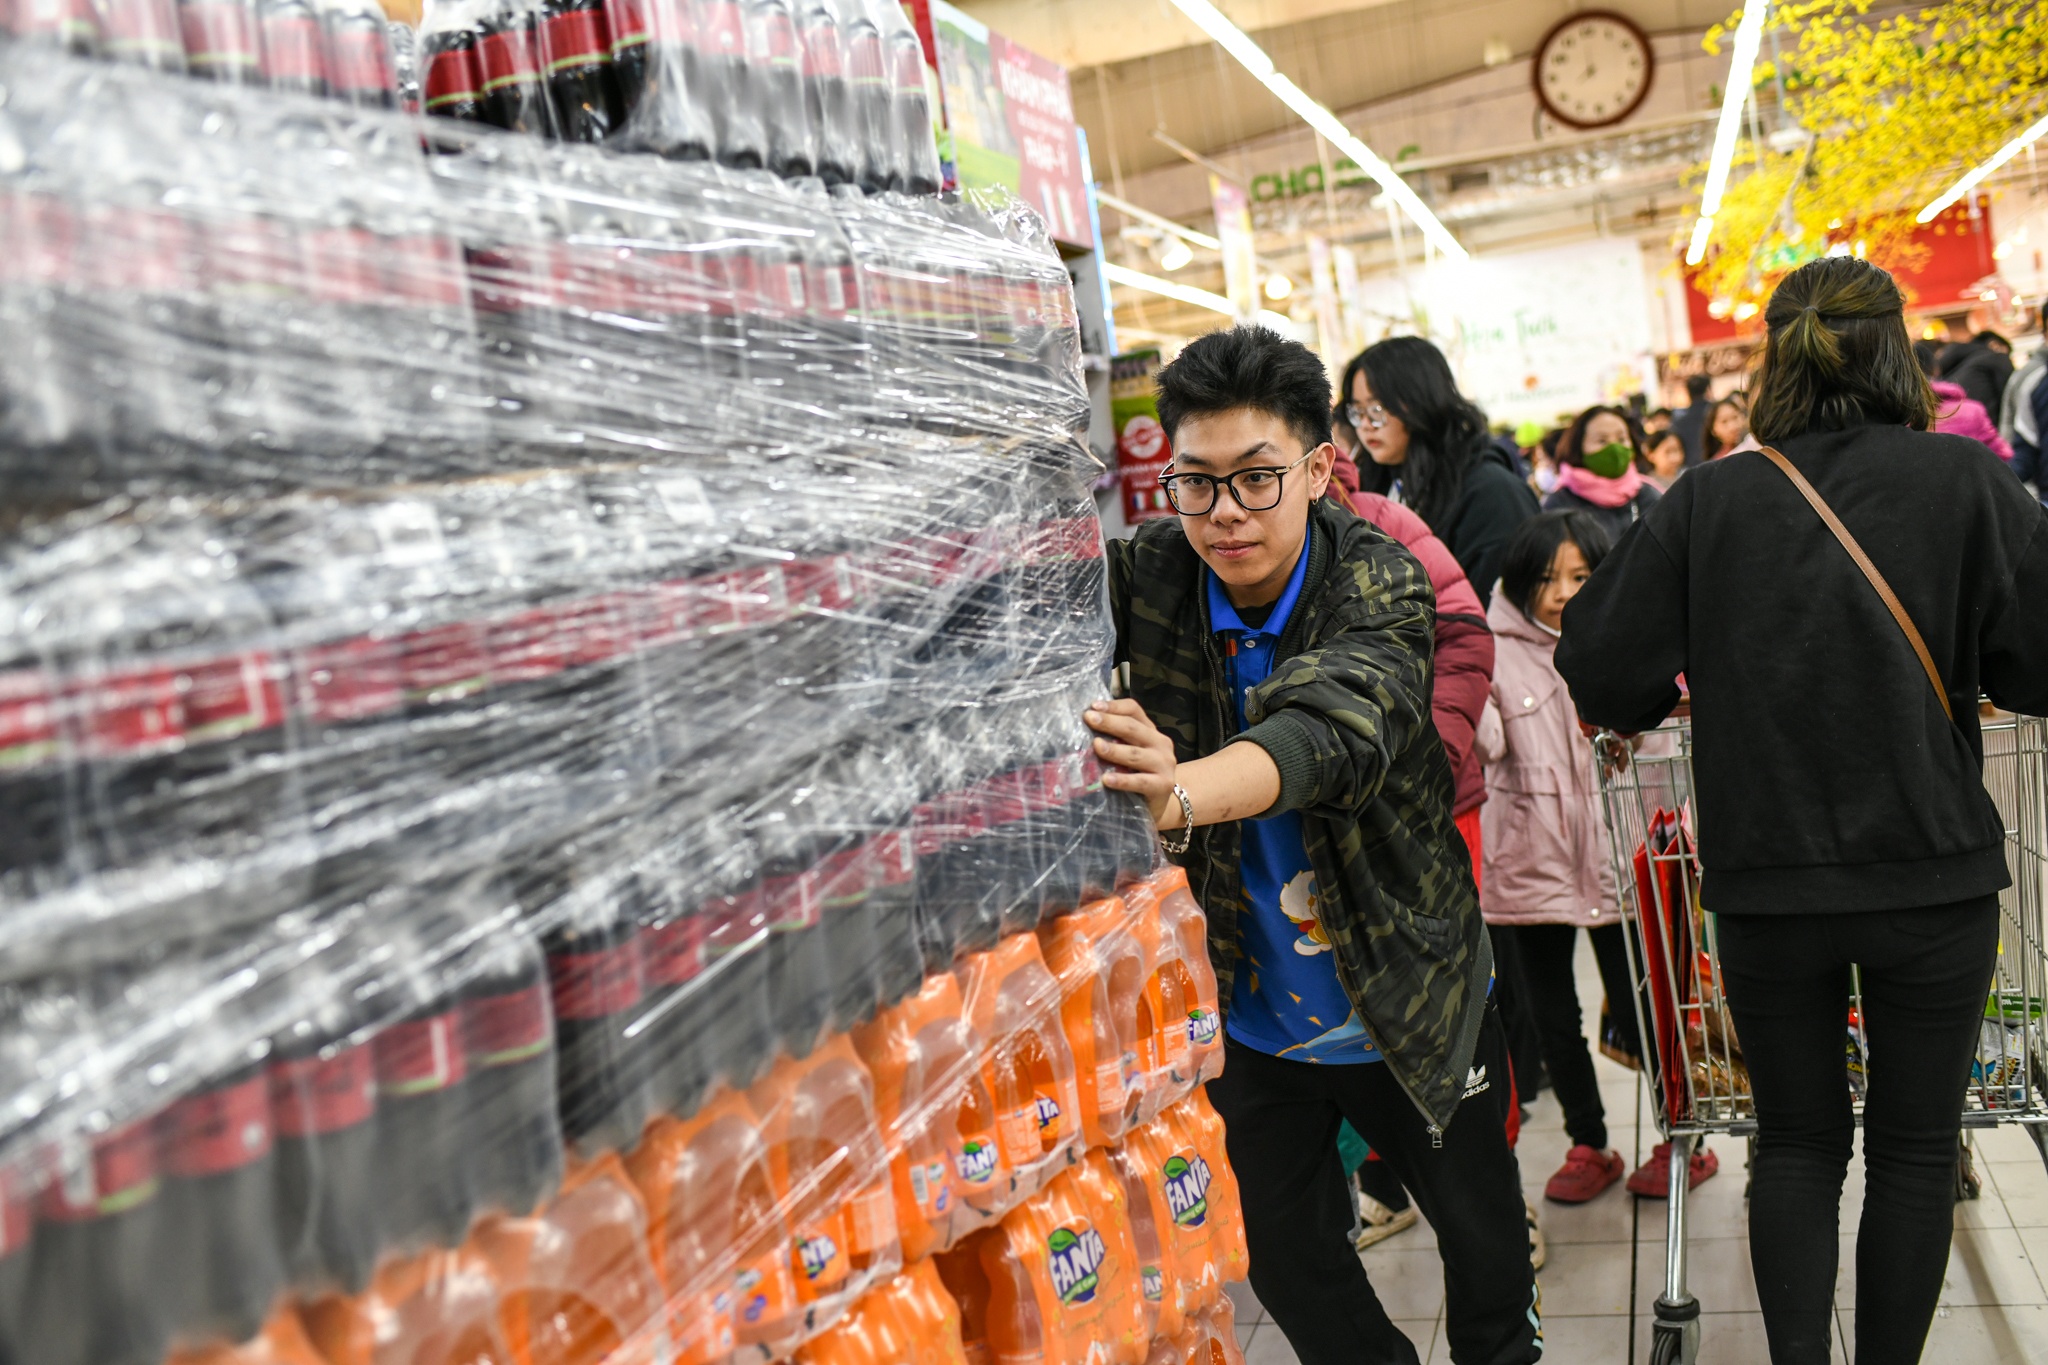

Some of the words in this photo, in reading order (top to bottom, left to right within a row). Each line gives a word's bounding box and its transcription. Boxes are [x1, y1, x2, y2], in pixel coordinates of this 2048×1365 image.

[954, 1142, 998, 1179] FANT
[1164, 1156, 1211, 1220] FANTA
[1049, 1228, 1105, 1298] FANTA
